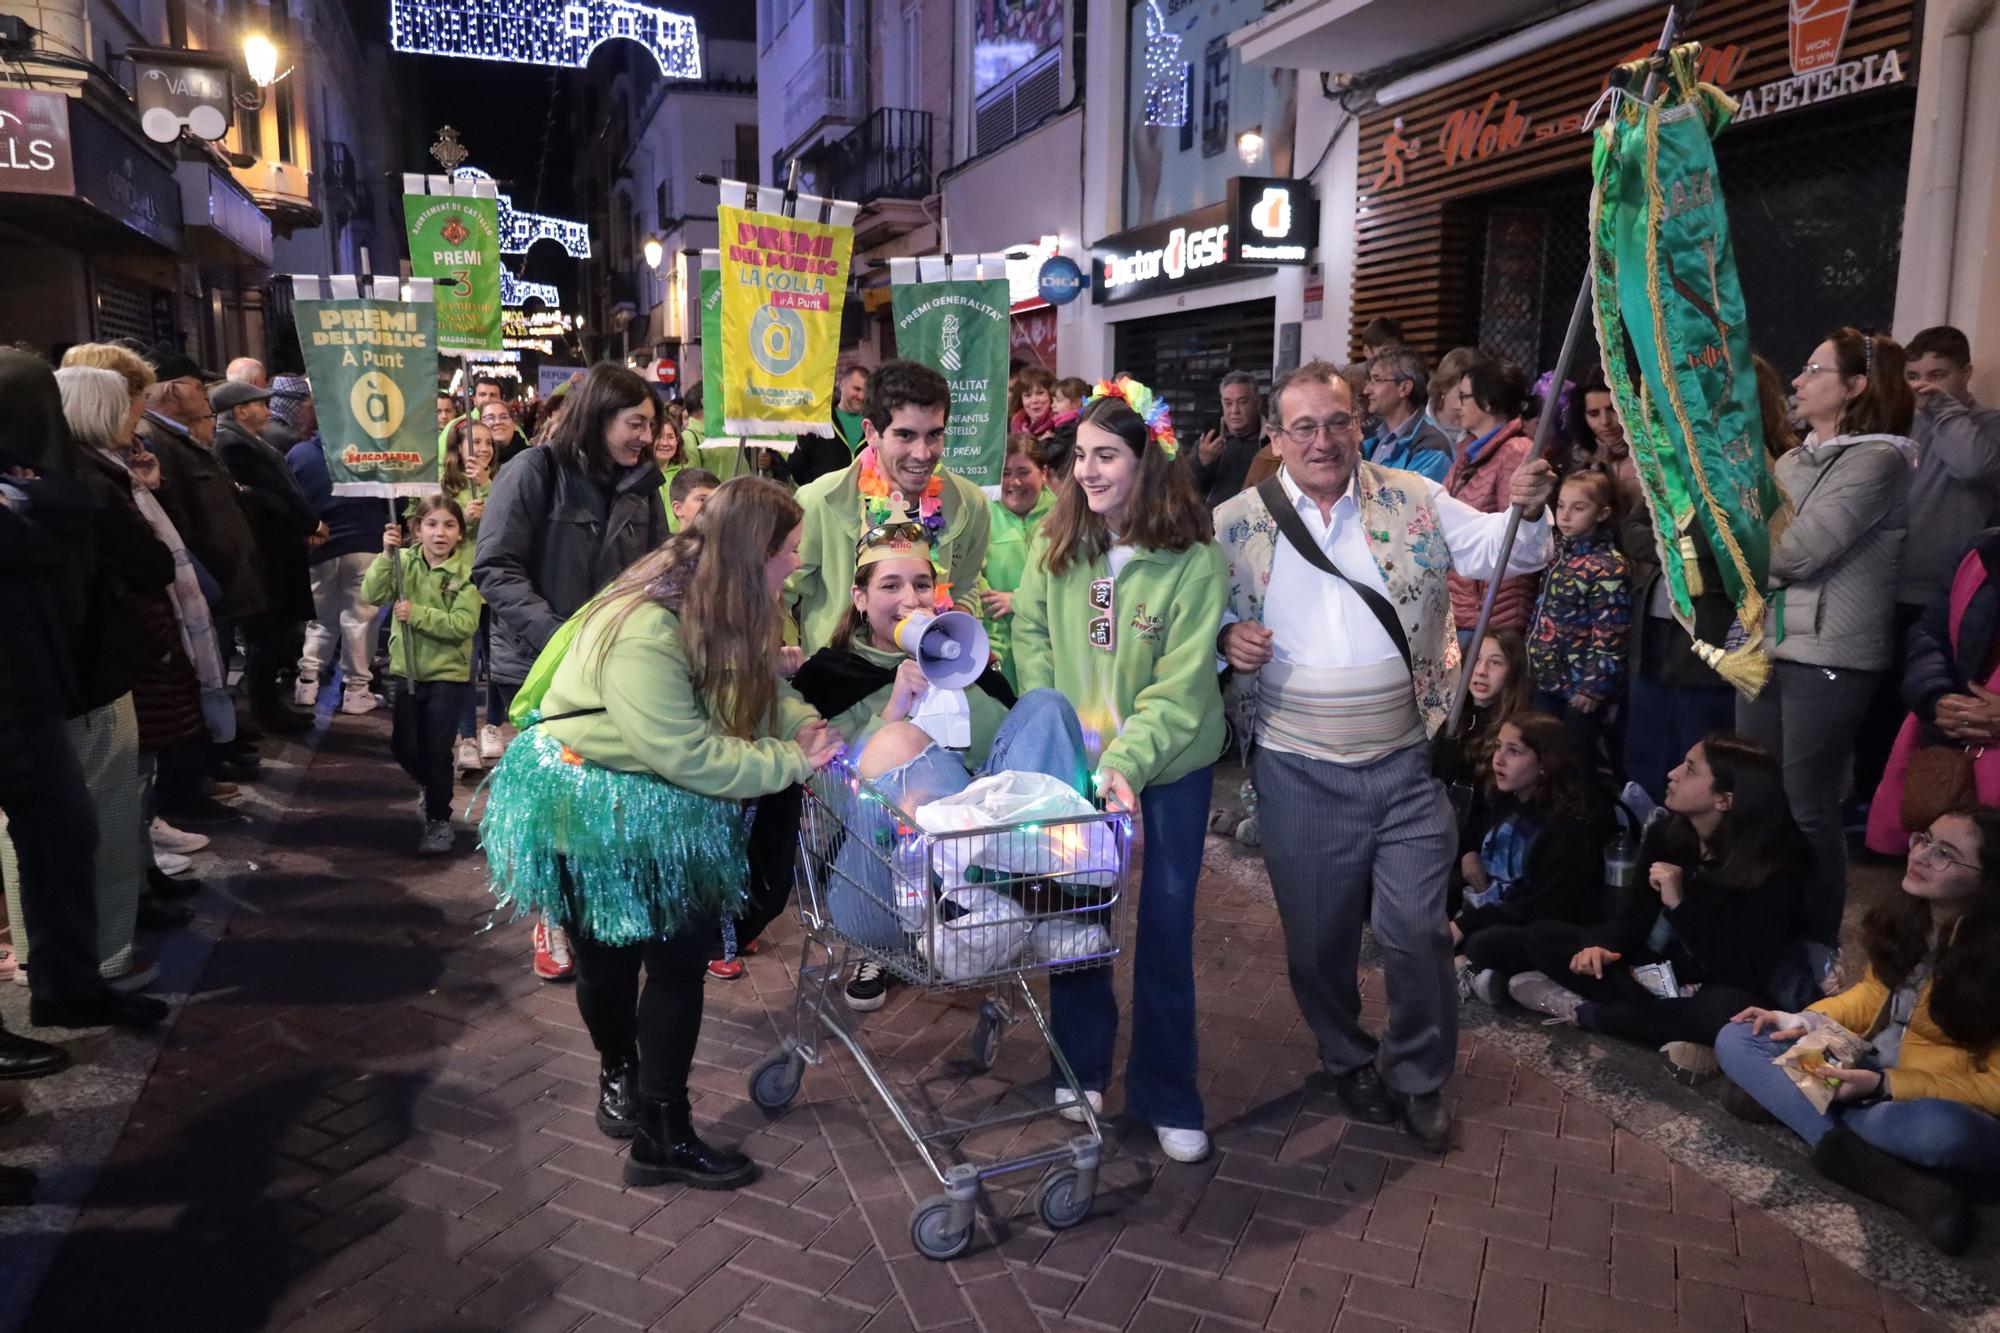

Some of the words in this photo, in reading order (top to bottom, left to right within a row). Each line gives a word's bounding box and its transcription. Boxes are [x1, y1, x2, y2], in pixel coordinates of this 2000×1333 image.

[1730, 49, 1904, 123] AFETERIA
[1439, 91, 1531, 167] Wok
[0, 137, 55, 171] LS
[452, 202, 461, 212] DE
[737, 222, 834, 258] PREMI
[433, 250, 481, 266] PREMI
[729, 245, 763, 266] DEL
[767, 252, 839, 277] PUBLIC
[1104, 248, 1163, 289] Doctor
[451, 270, 473, 298] 3
[740, 267, 761, 287] LA
[765, 271, 825, 295] COLLA
[1041, 277, 1080, 287] DIGI
[705, 285, 722, 311] AJUN
[797, 297, 821, 310] Punt
[319, 309, 417, 332] PREMI
[900, 302, 932, 329] PREMI
[932, 295, 1003, 322] GENERALITAT
[312, 332, 355, 346] DEL
[356, 331, 427, 348] PUBLIC
[342, 346, 358, 367] À
[363, 350, 405, 368] Punt
[947, 380, 989, 390] RALITAT
[950, 393, 986, 403] CIANA
[944, 426, 977, 436] ASTELLÓ
[954, 446, 982, 457] PREMI
[967, 467, 988, 475] 2023
